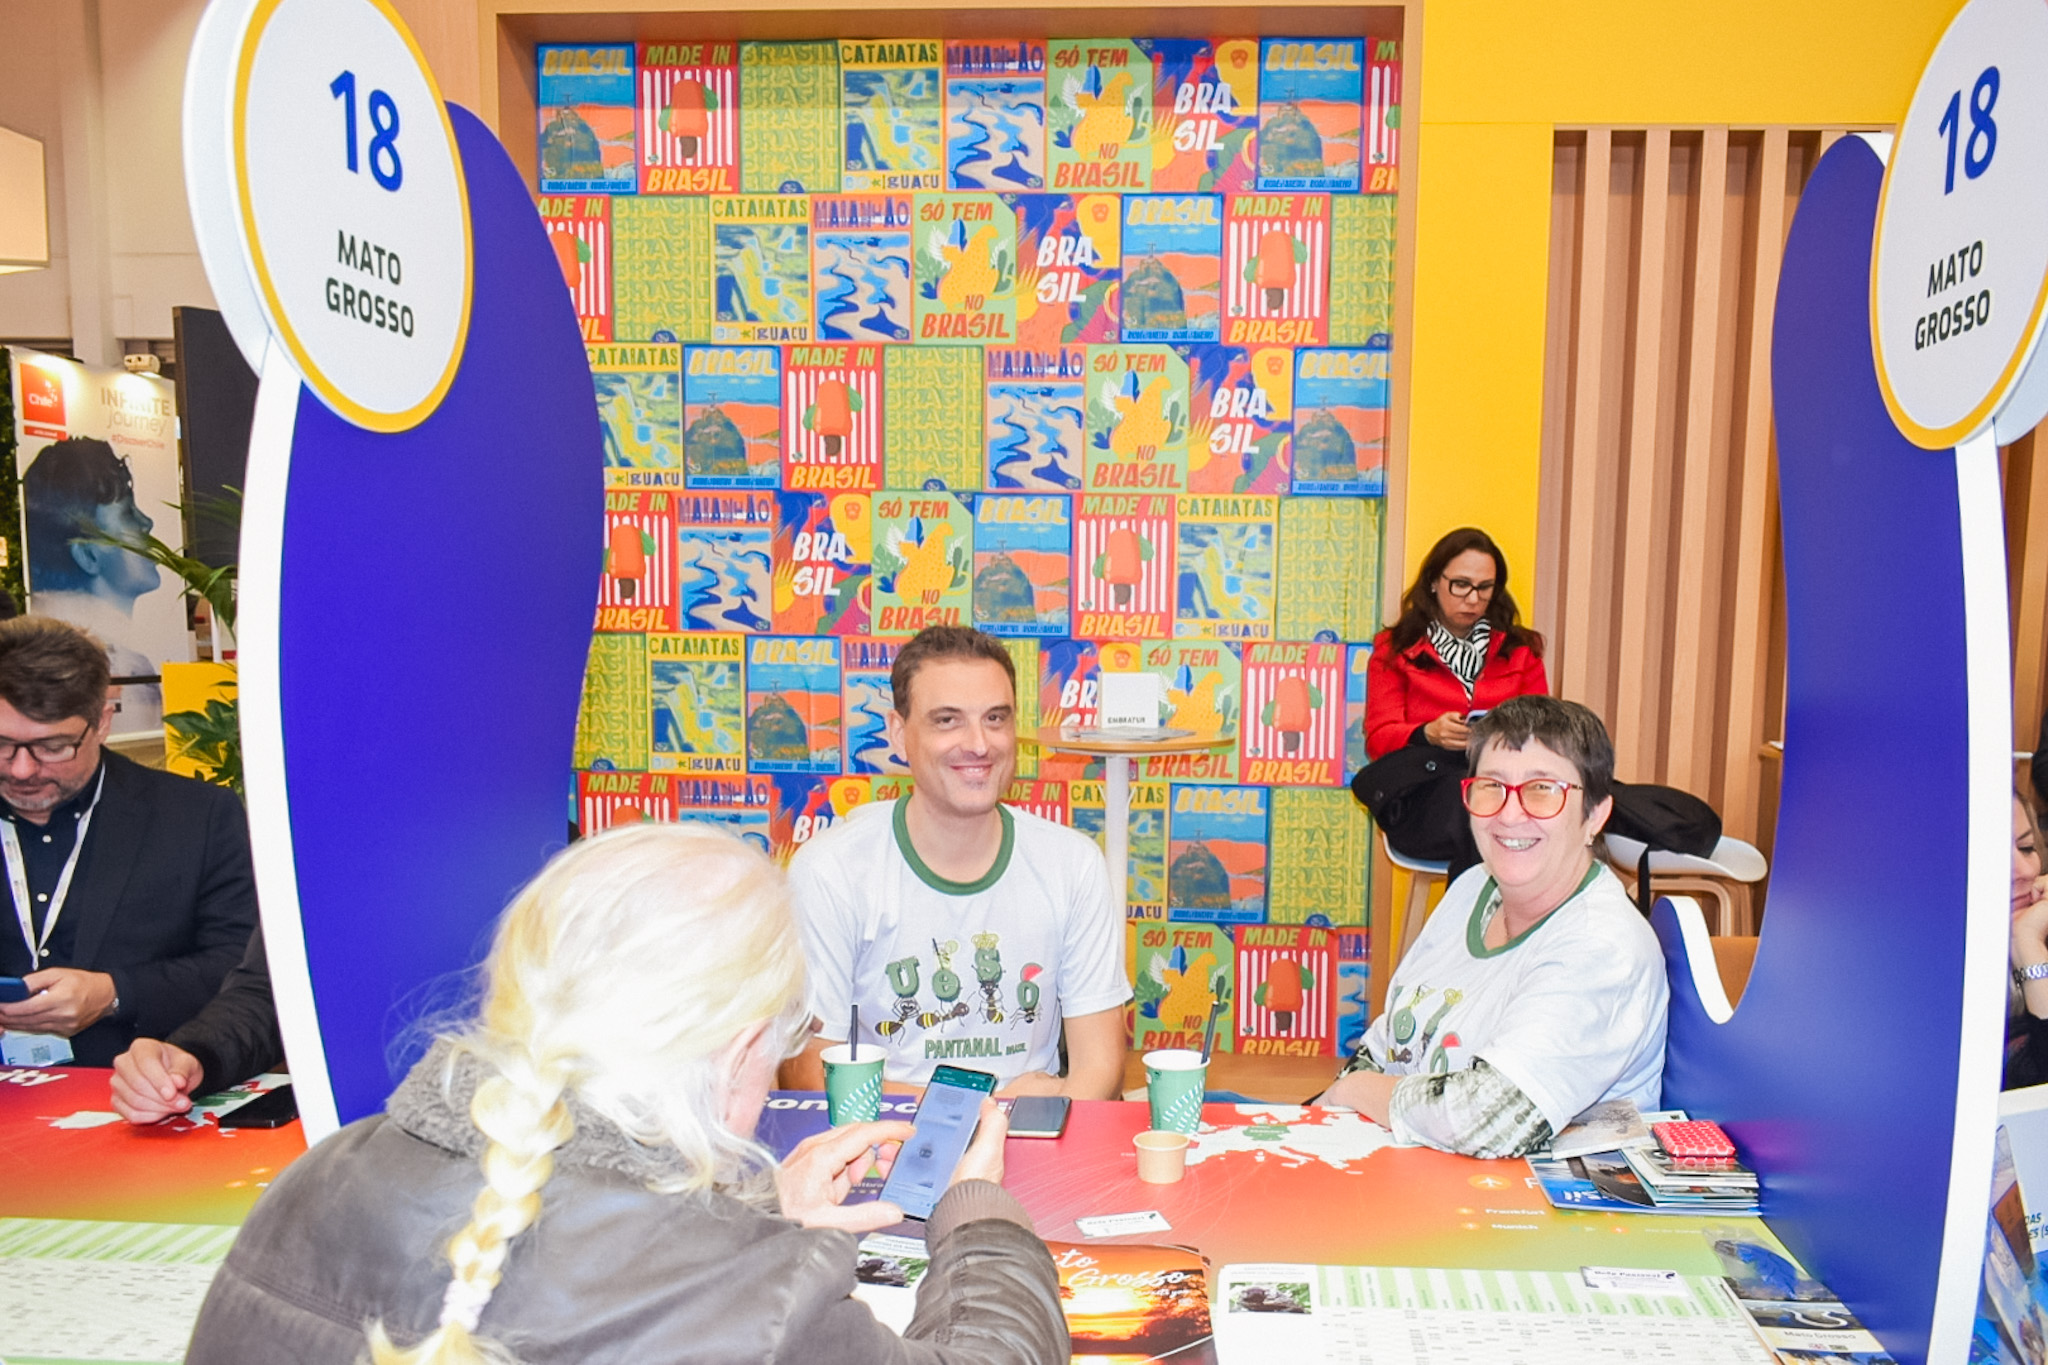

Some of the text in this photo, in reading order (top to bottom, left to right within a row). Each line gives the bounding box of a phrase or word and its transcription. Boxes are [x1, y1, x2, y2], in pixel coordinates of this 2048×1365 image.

[543, 49, 631, 76] BRASIL
[645, 45, 731, 66] MADE IN
[842, 43, 937, 63] CATARATAS
[1055, 45, 1130, 68] SÓ TEM
[1265, 44, 1359, 71] BRASIL
[1174, 83, 1231, 114] BRA
[330, 70, 403, 192] 18
[1173, 120, 1224, 151] SIL
[1939, 66, 2000, 196] 18
[1099, 143, 1119, 159] NO
[646, 168, 733, 192] BRASIL
[1054, 162, 1145, 188] BRASIL
[538, 198, 603, 217] ADE IN
[920, 199, 993, 222] SÓ TEM
[1127, 198, 1219, 226] BRASIL
[1232, 196, 1323, 216] MADE IN
[337, 230, 401, 285] MATO
[1037, 236, 1093, 267] BRA
[1927, 240, 1983, 298] MATO
[1036, 272, 1086, 303] SIL
[326, 278, 414, 338] GROSSO
[964, 294, 984, 311] NO
[921, 313, 1010, 338] BRASIL
[1229, 320, 1318, 343] BRASIL
[1914, 289, 1990, 350] GROSSO
[688, 349, 778, 376] BRASIL
[790, 347, 875, 367] MADE IN
[1093, 350, 1167, 373] SÓ TEM
[1300, 352, 1391, 379] BRASIL
[1209, 387, 1267, 419] BRA
[1209, 423, 1260, 454] SIL
[1137, 445, 1157, 462] NO
[790, 465, 876, 489] BRASIL
[1092, 463, 1181, 488] BRASIL
[605, 493, 668, 511] ADE IN
[878, 497, 949, 519] SÓ TEM
[978, 497, 1068, 525] BRASIL
[1082, 496, 1167, 516] MADE IN
[792, 532, 846, 561] BRA
[792, 566, 840, 596] SIL
[921, 589, 940, 605] NO
[1079, 613, 1165, 637] BRASIL
[751, 639, 838, 665] BRASIL
[1148, 646, 1219, 667] SÓ TEM
[1251, 644, 1308, 664] MADE
[1317, 645, 1337, 665] IN
[1146, 755, 1234, 778] BRASIL
[1247, 761, 1334, 784] BRASIL
[587, 774, 668, 794] MADE IN
[1042, 783, 1061, 801] IN
[1175, 788, 1265, 814] BRASIL
[1143, 926, 1213, 948] SÓ TEM
[1243, 927, 1298, 947] MADE
[1309, 928, 1327, 947] IN
[1184, 1014, 1202, 1029] NO
[925, 1038, 1002, 1059] PANTANAL
[1068, 1268, 1191, 1288] Grosso
